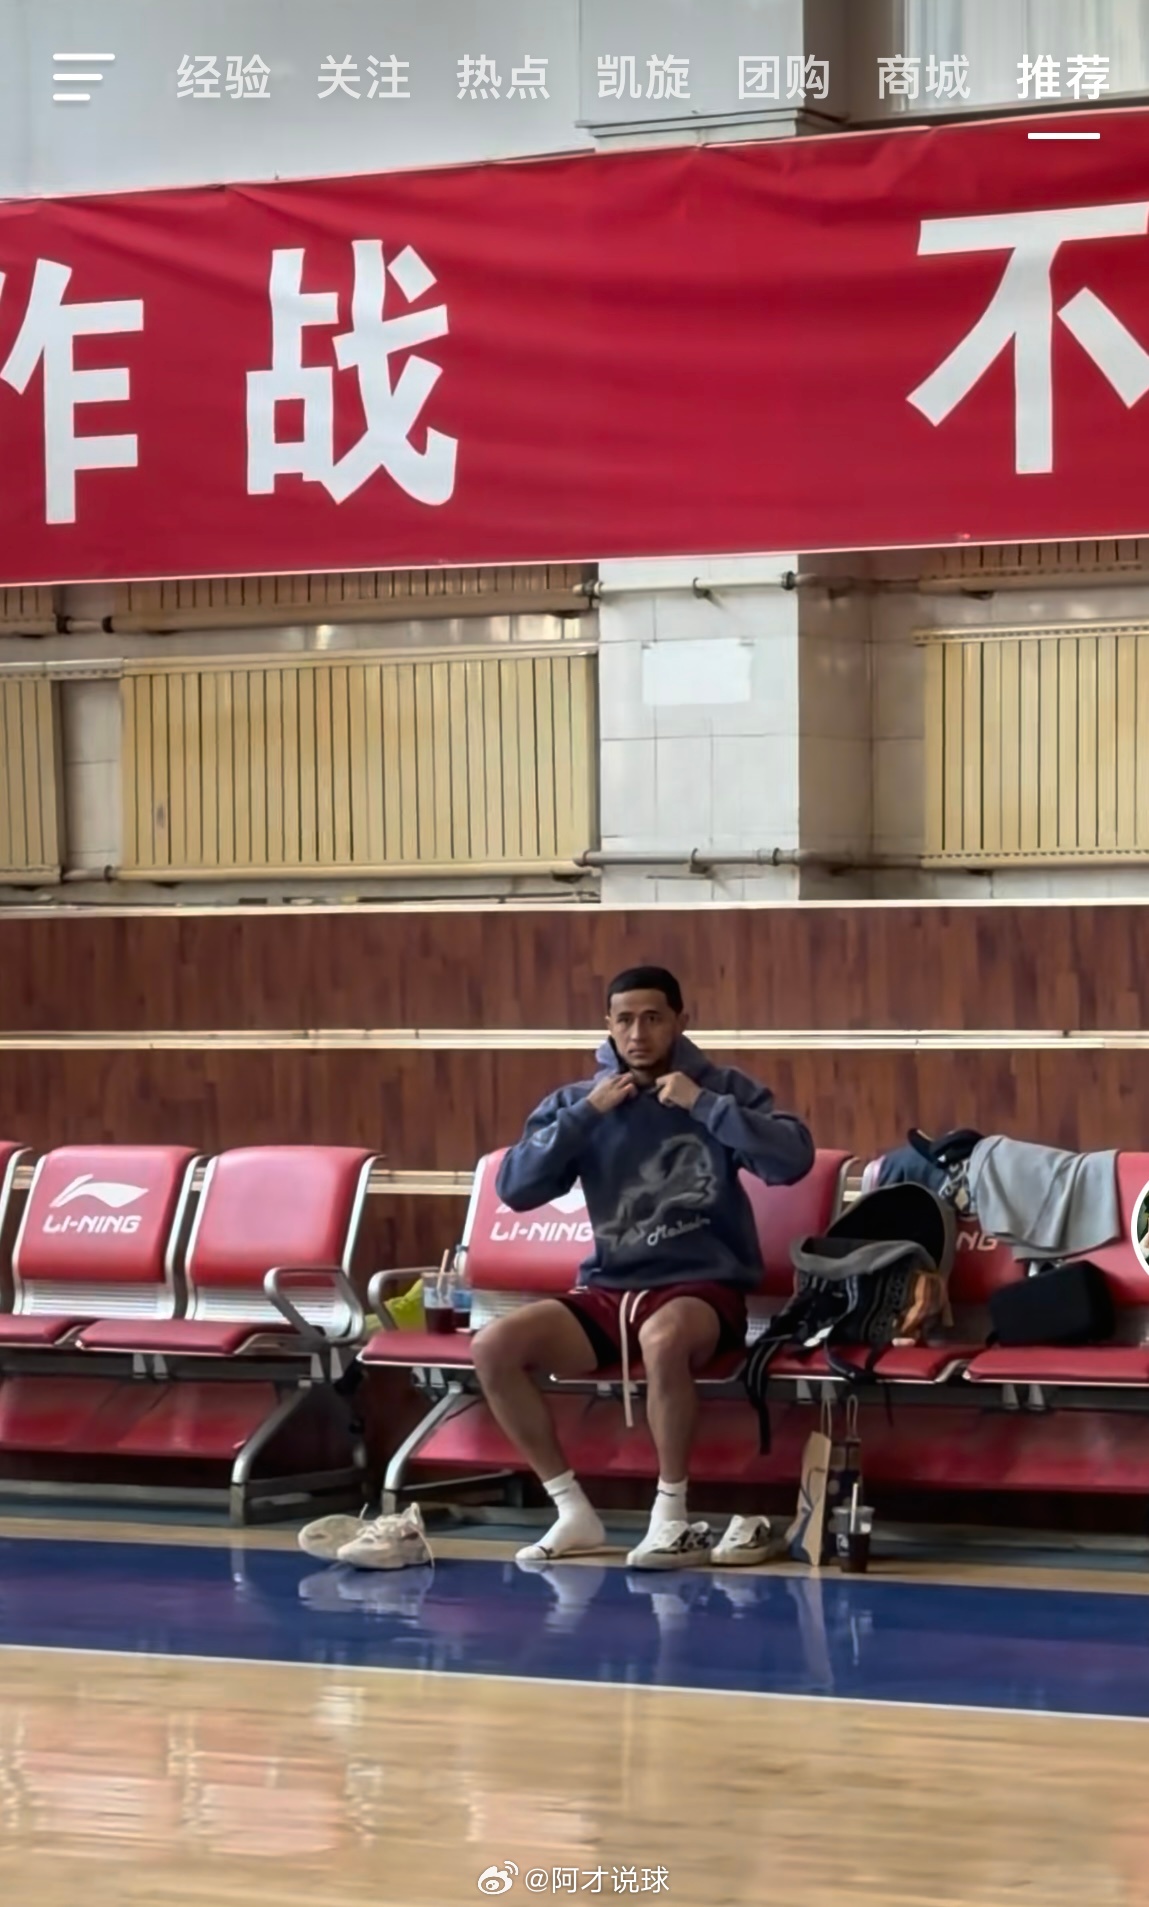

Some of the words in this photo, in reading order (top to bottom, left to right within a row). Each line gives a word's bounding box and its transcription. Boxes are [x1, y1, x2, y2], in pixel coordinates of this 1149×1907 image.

[907, 202, 1149, 475] 不
[43, 1214, 142, 1233] LI-NING
[490, 1221, 595, 1242] LI-NING
